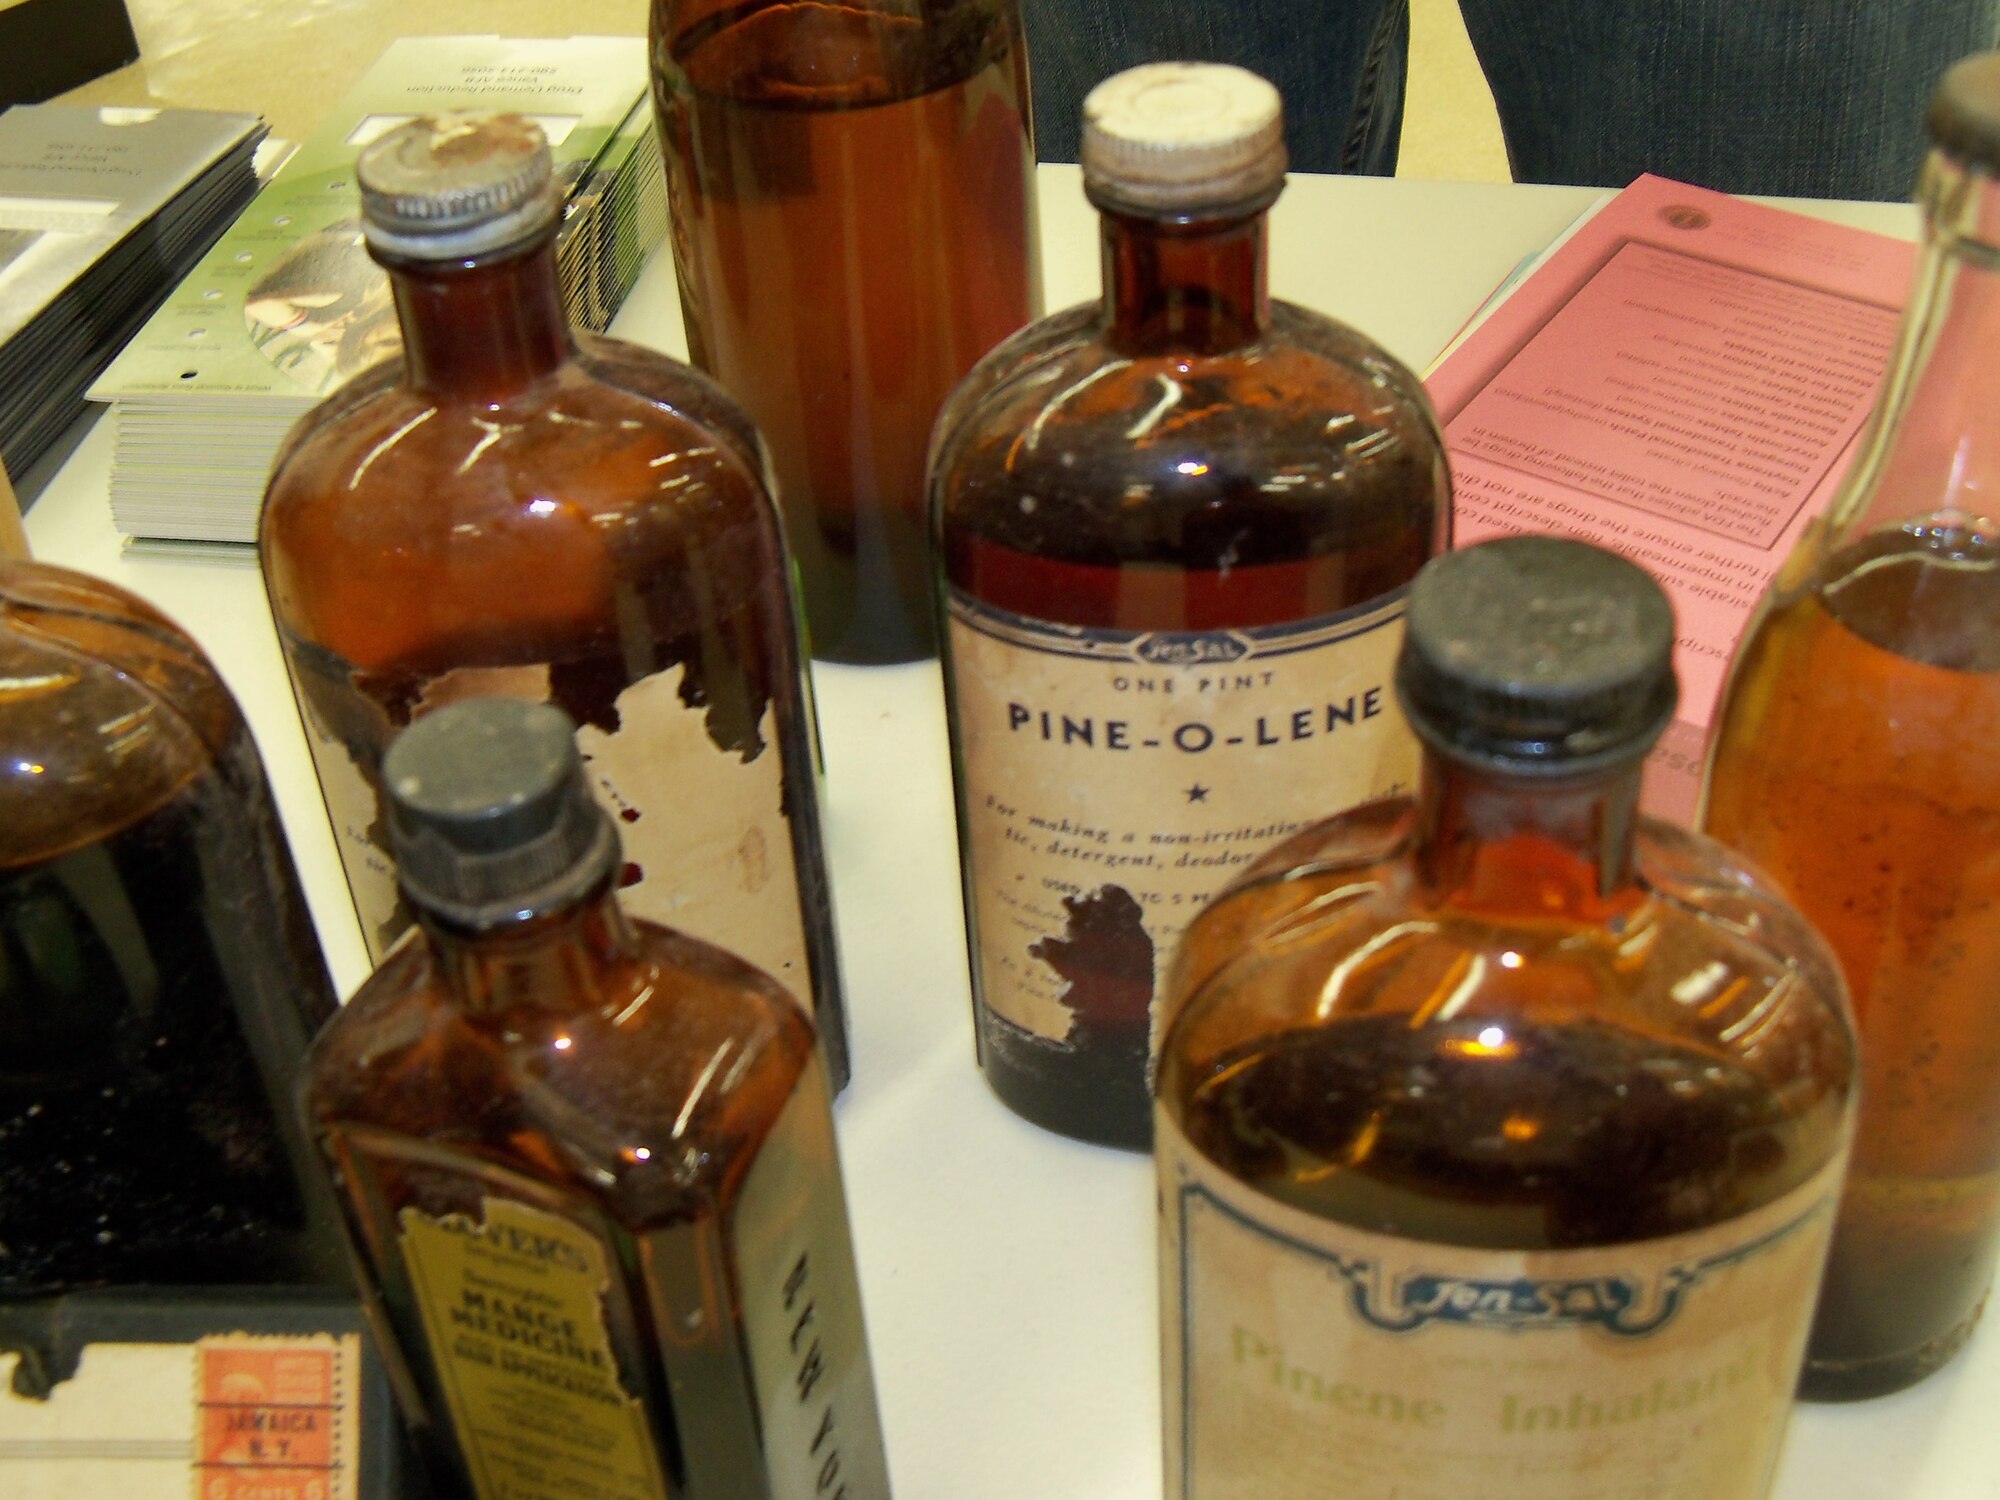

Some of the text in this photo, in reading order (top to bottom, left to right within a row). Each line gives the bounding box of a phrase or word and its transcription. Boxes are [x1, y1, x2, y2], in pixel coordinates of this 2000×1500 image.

[1601, 404, 1655, 425] System
[1484, 431, 1538, 453] thrown
[1606, 422, 1648, 439] Patch
[1651, 420, 1739, 451] Transdermal
[1646, 434, 1734, 465] Transdermal
[1552, 452, 1608, 475] instead
[1457, 436, 1764, 537] The FDA advises that the following drugs be
[1480, 479, 1516, 496] not
[1606, 469, 1647, 487] toilet
[1644, 481, 1673, 495] the
[1513, 490, 1545, 505] are
[1671, 490, 1717, 509] down
[1489, 499, 1606, 544] non-descript
[1543, 499, 1599, 523] drugs
[1715, 503, 1773, 526] flushed
[1477, 514, 1522, 534] used
[1596, 517, 1630, 534] the
[1630, 528, 1695, 554] ensure
[1605, 536, 1736, 586] impermeable,
[1694, 548, 1762, 576] further
[1113, 671, 1275, 694] ONE PINT
[1008, 685, 1384, 754] PINE-O-LENE
[1028, 813, 1111, 844] making
[1121, 831, 1136, 844] a
[1045, 840, 1164, 870] detergent,
[460, 1287, 577, 1338] MANGE
[450, 1306, 606, 1368] MEDICINE
[1231, 1325, 1447, 1430] Pinene
[226, 1413, 318, 1433] JAMAICA
